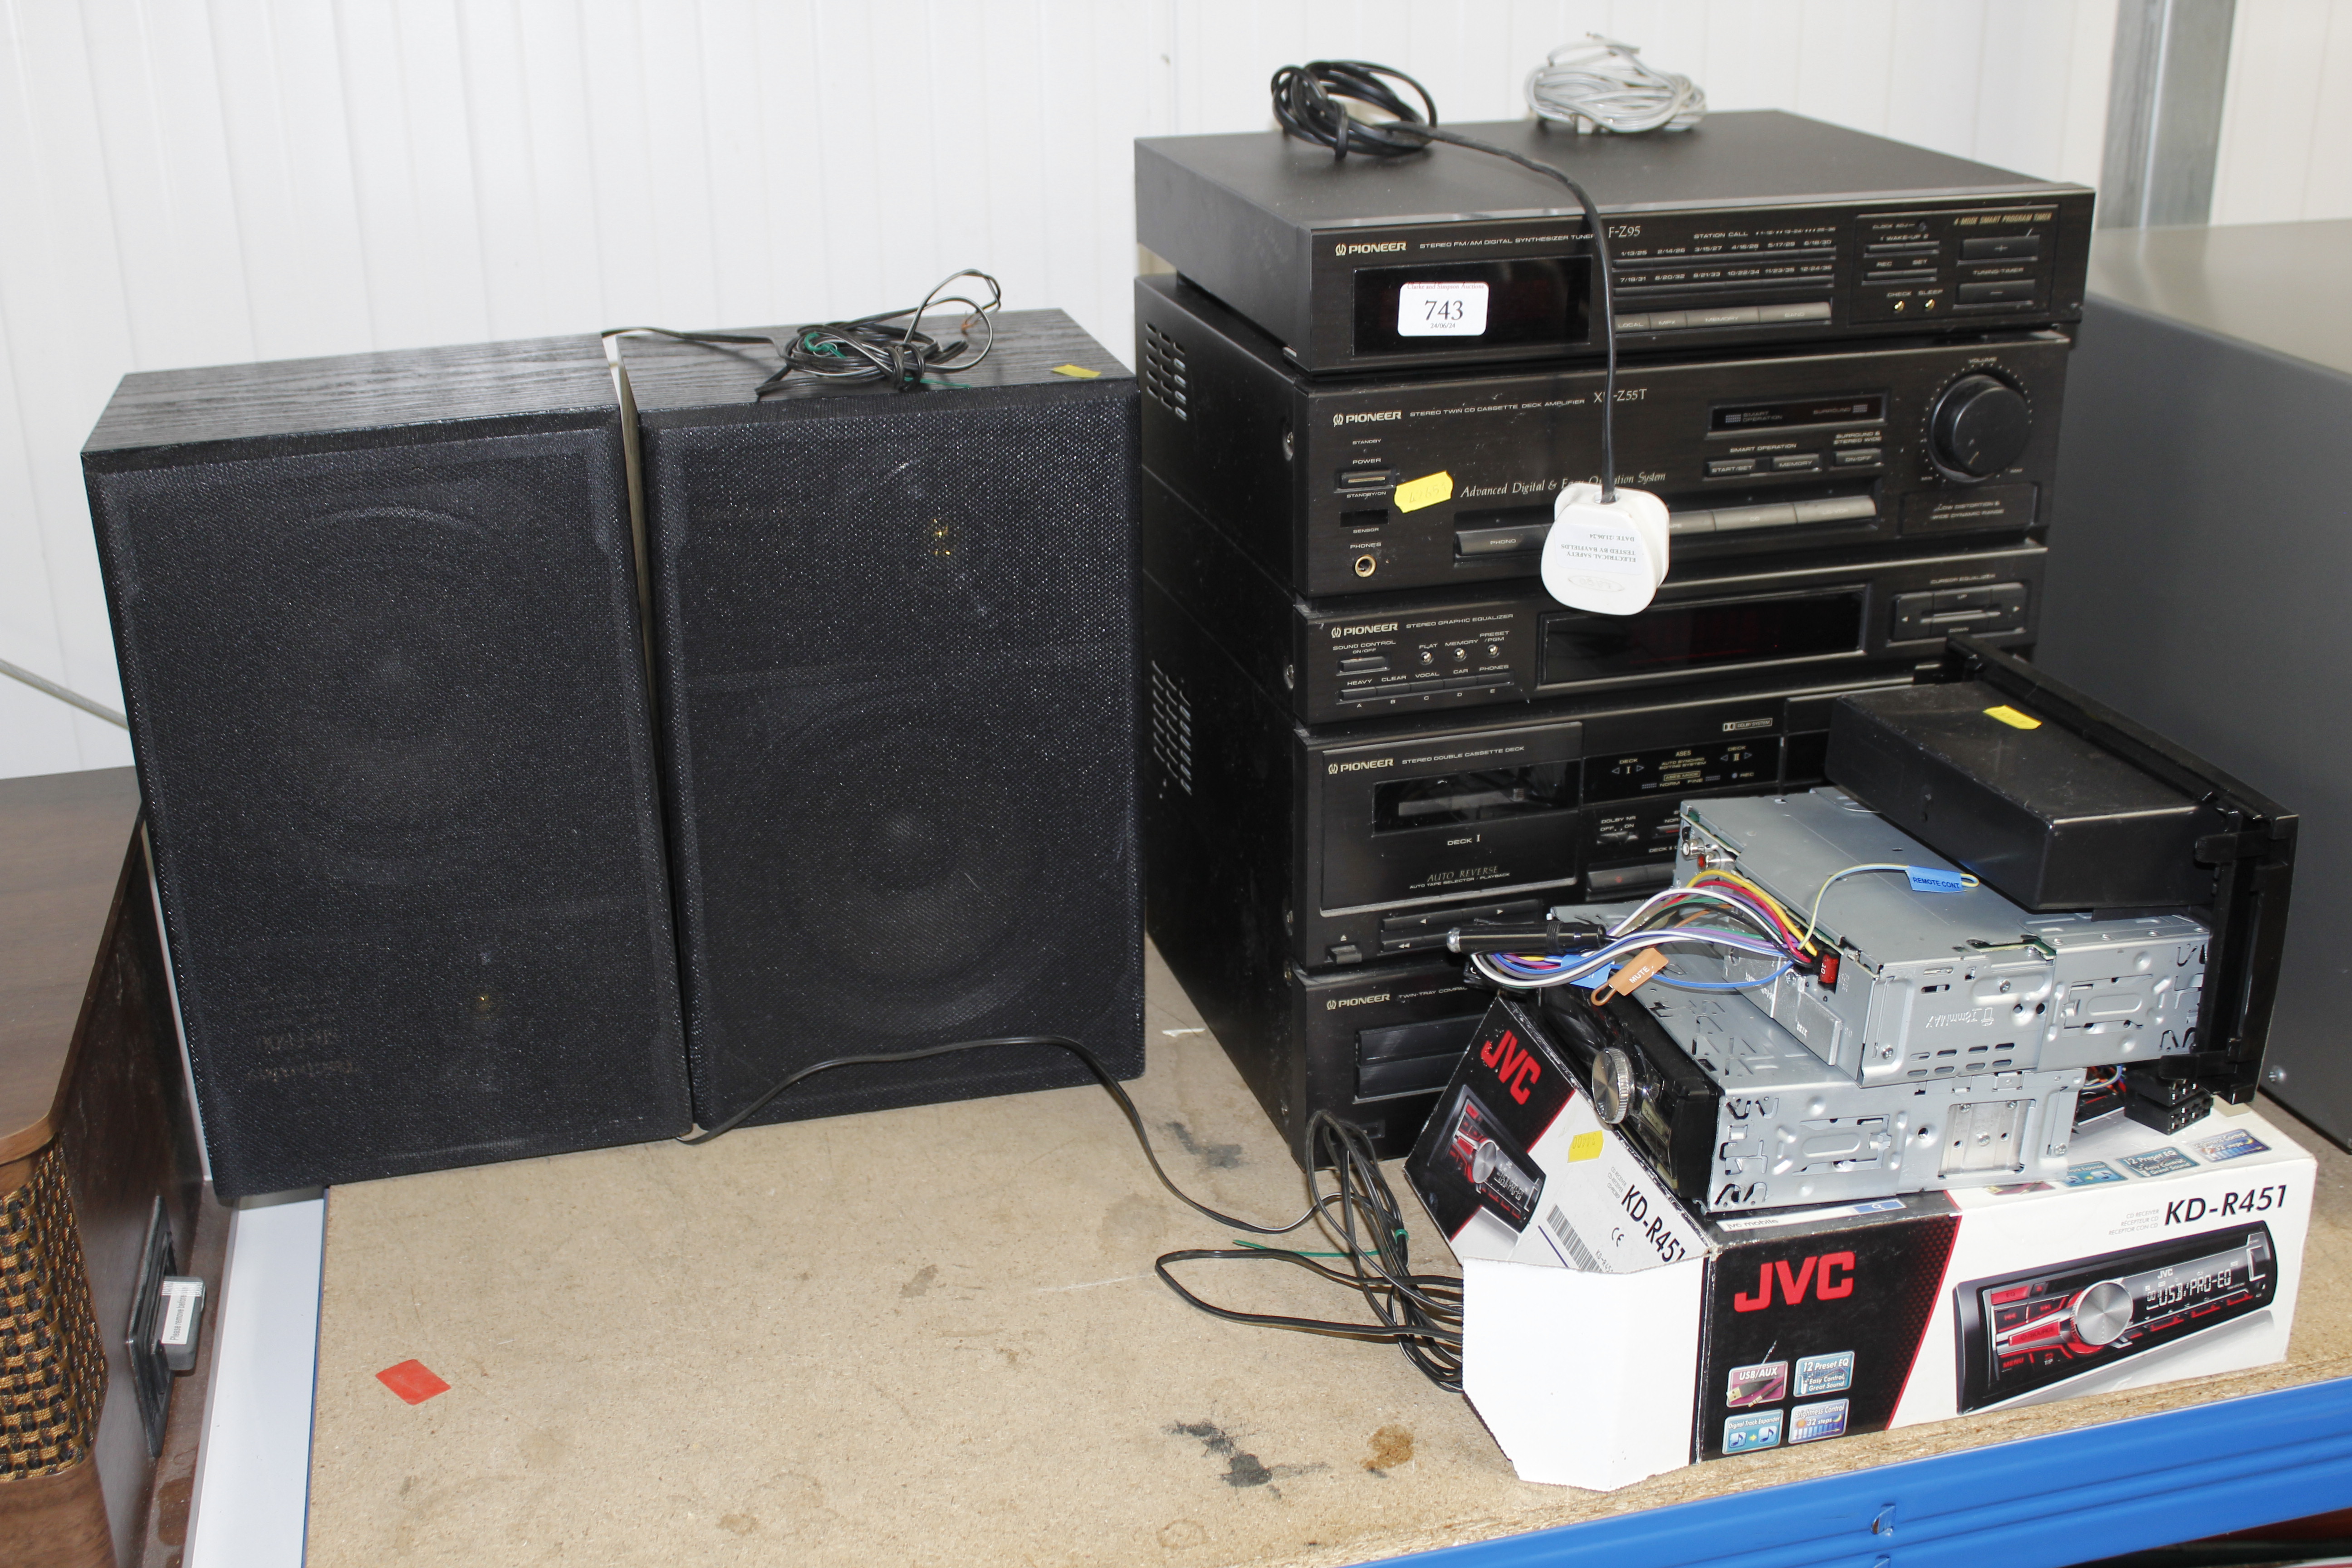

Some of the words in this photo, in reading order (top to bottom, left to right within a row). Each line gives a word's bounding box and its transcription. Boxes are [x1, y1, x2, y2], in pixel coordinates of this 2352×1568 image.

[1608, 225, 1640, 238] F-Z95
[1515, 235, 1568, 244] SYNTHESIZER
[1348, 242, 1406, 254] PIONEER
[1425, 300, 1463, 320] 743
[1593, 388, 1647, 403] X-Z55T
[1477, 404, 1518, 412] CASSETTE
[1346, 411, 1401, 423] PIONEER
[1460, 480, 1507, 498] Advanced
[1511, 481, 1544, 495] Digital
[1548, 480, 1557, 489] &
[1638, 471, 1666, 485] System
[1561, 544, 1598, 552] BAYFIELDS
[1595, 554, 1636, 562] ELECTRICAL
[1344, 623, 1398, 636] PIONEER
[1465, 749, 1503, 758] CASSETTE
[1341, 758, 1394, 772] PIONEER
[1427, 872, 1454, 882] AUTO
[1460, 866, 1498, 877] REVERSE
[1912, 877, 1940, 887] REMOTE
[1941, 881, 1961, 889] CONT
[1628, 965, 1651, 984] MUTE
[1338, 994, 1390, 1008] PIONEER
[1481, 1030, 1541, 1105] JVC
[2123, 1157, 2137, 1165] 12
[2137, 1153, 2163, 1163] Preset
[2164, 1184, 2288, 1226] KD-R451
[2135, 1209, 2159, 1217] RECEIVER
[1621, 1184, 1686, 1263] KD-R451
[1725, 1219, 1742, 1230] jvc
[1744, 1218, 1779, 1228] mobile
[2157, 1268, 2173, 1279] JVC
[1734, 1251, 1855, 1313] JVC
[170, 1325, 181, 1341] Please
[1803, 1362, 1813, 1372] 12
[1814, 1361, 1837, 1371] Preset
[1838, 1358, 1849, 1367] EQ
[2003, 1357, 2024, 1368] MENU
[1739, 1367, 1778, 1380] USB/AUX
[1795, 1406, 1823, 1419] Brightness
[1824, 1403, 1845, 1413] Control
[1729, 1421, 1744, 1429] Digital
[1758, 1416, 1780, 1425] Expander
